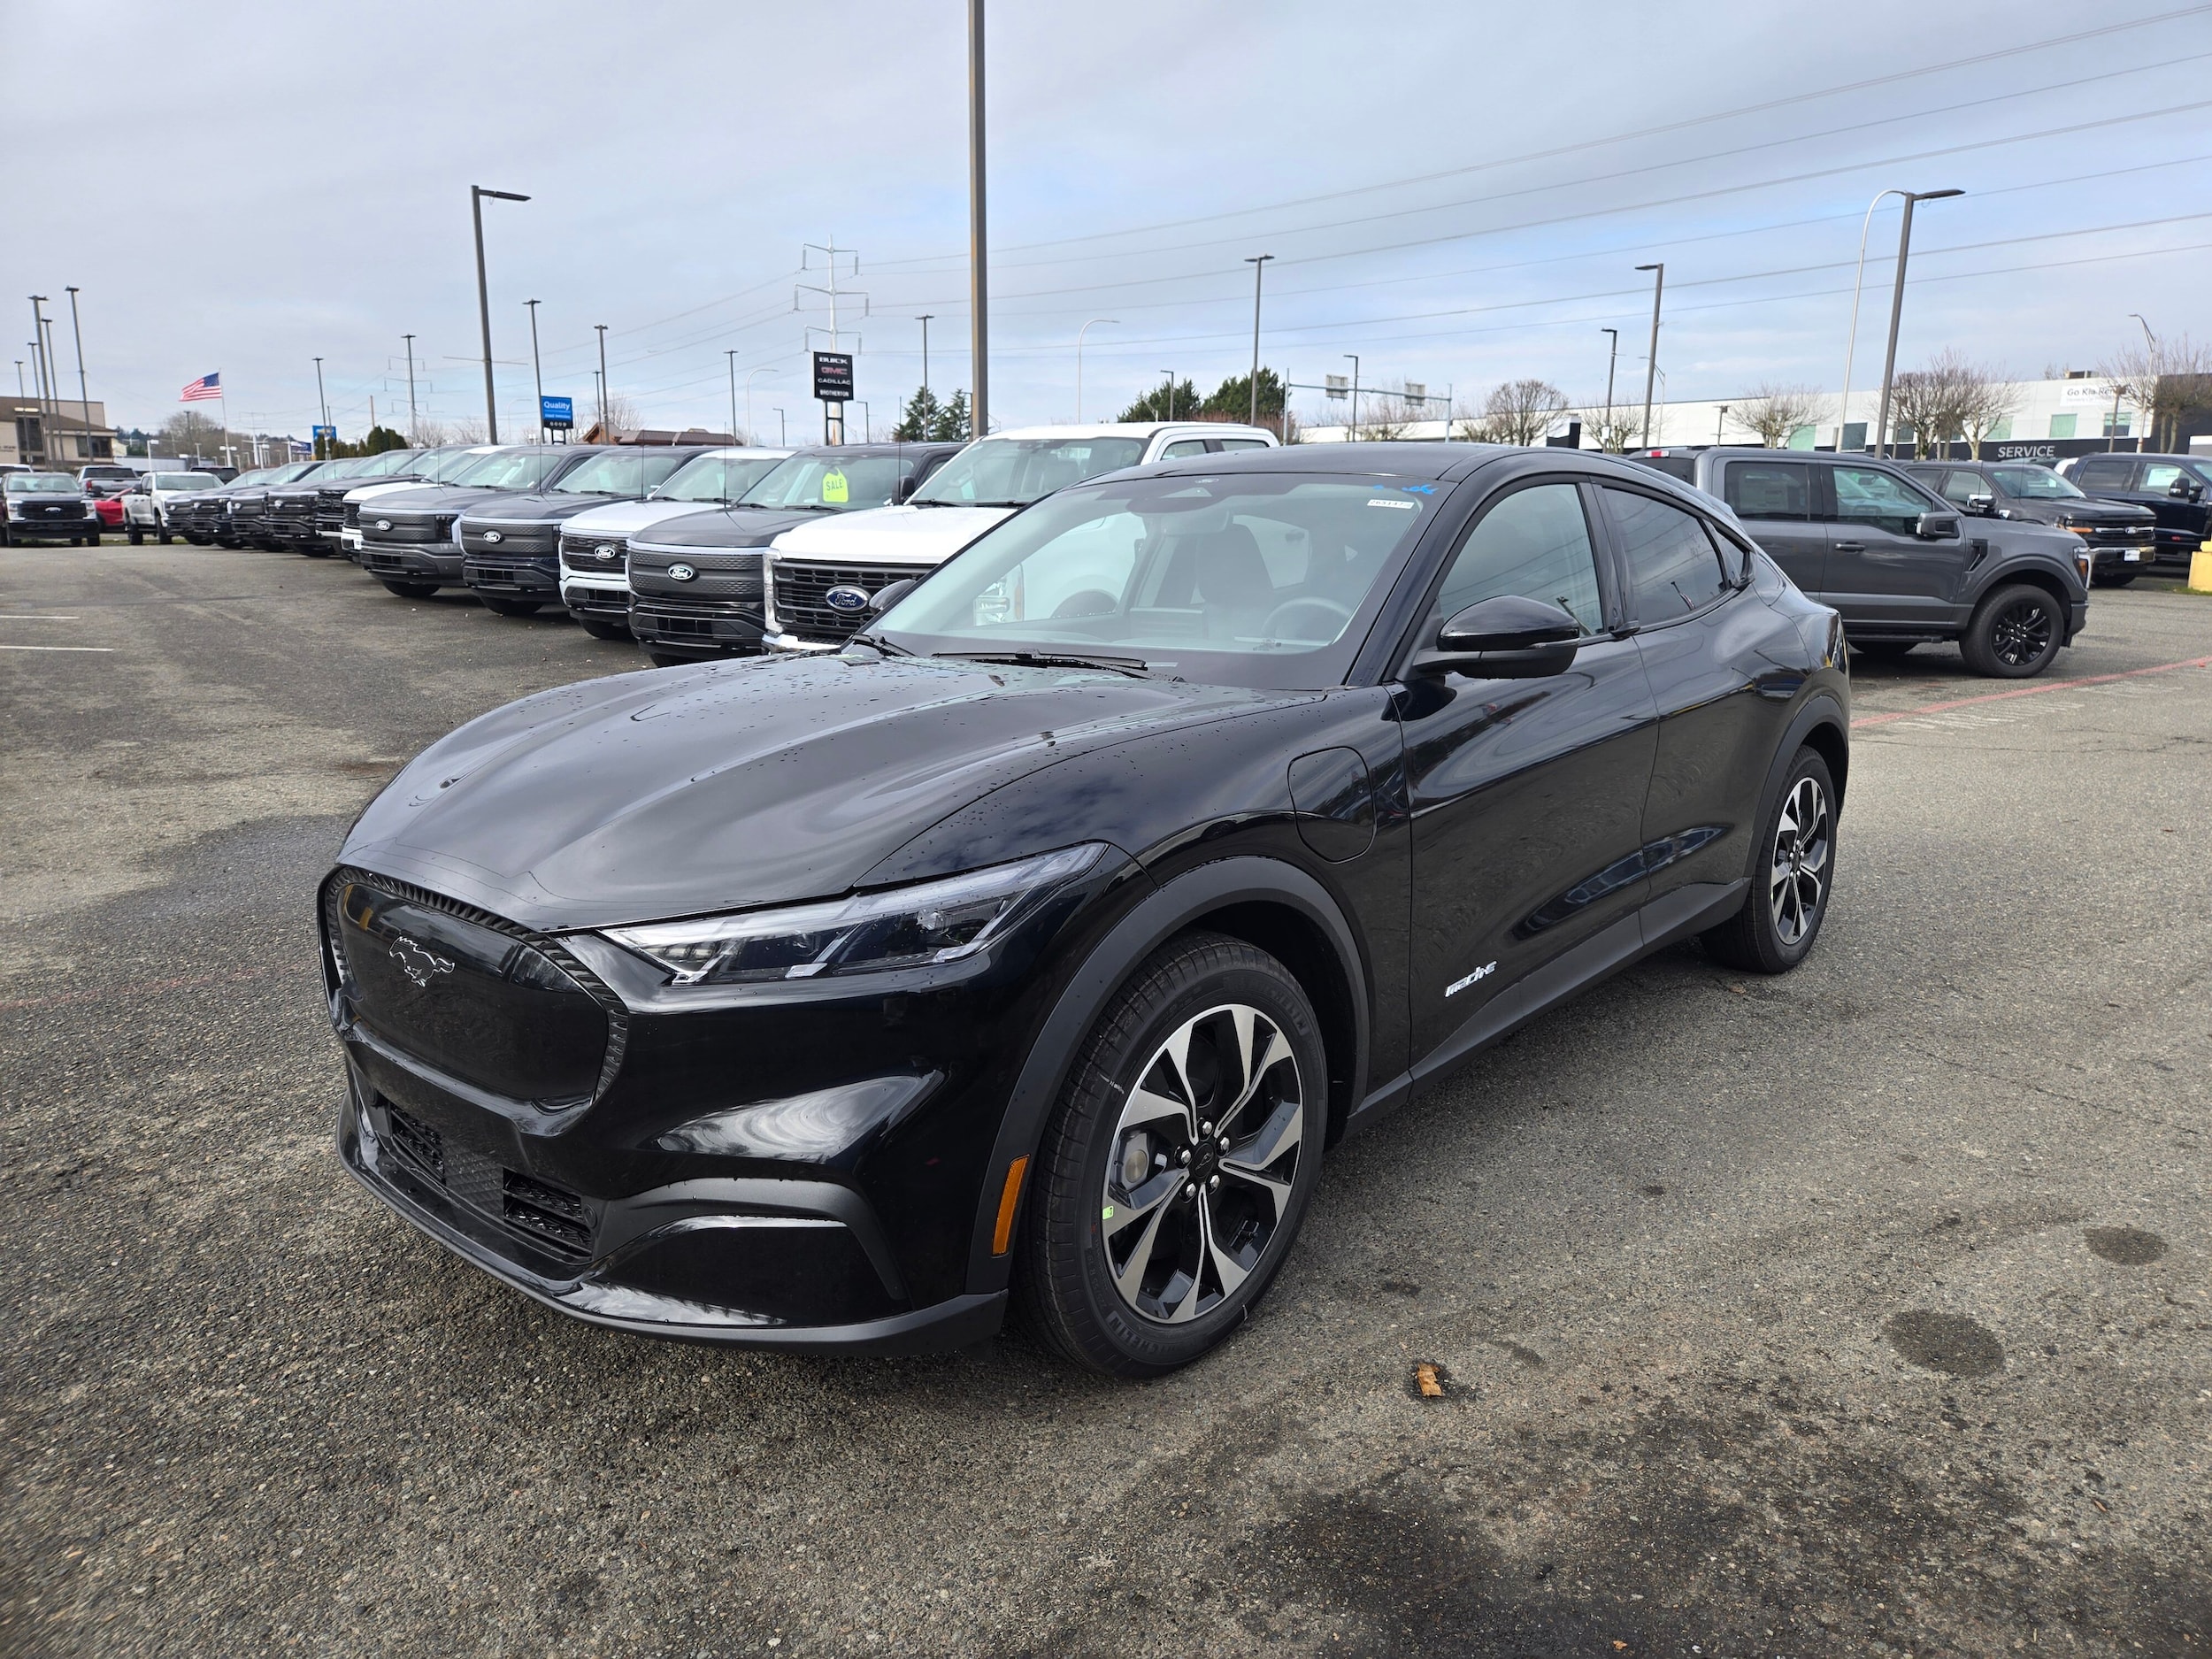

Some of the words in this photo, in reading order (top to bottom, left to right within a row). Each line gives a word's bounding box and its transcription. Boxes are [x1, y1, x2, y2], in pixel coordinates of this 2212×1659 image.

[821, 366, 848, 375] GMC
[543, 401, 571, 411] Quality
[1998, 445, 2055, 457] SERVICE
[826, 479, 843, 491] SALE
[1109, 1315, 1177, 1354] MICHELIN
